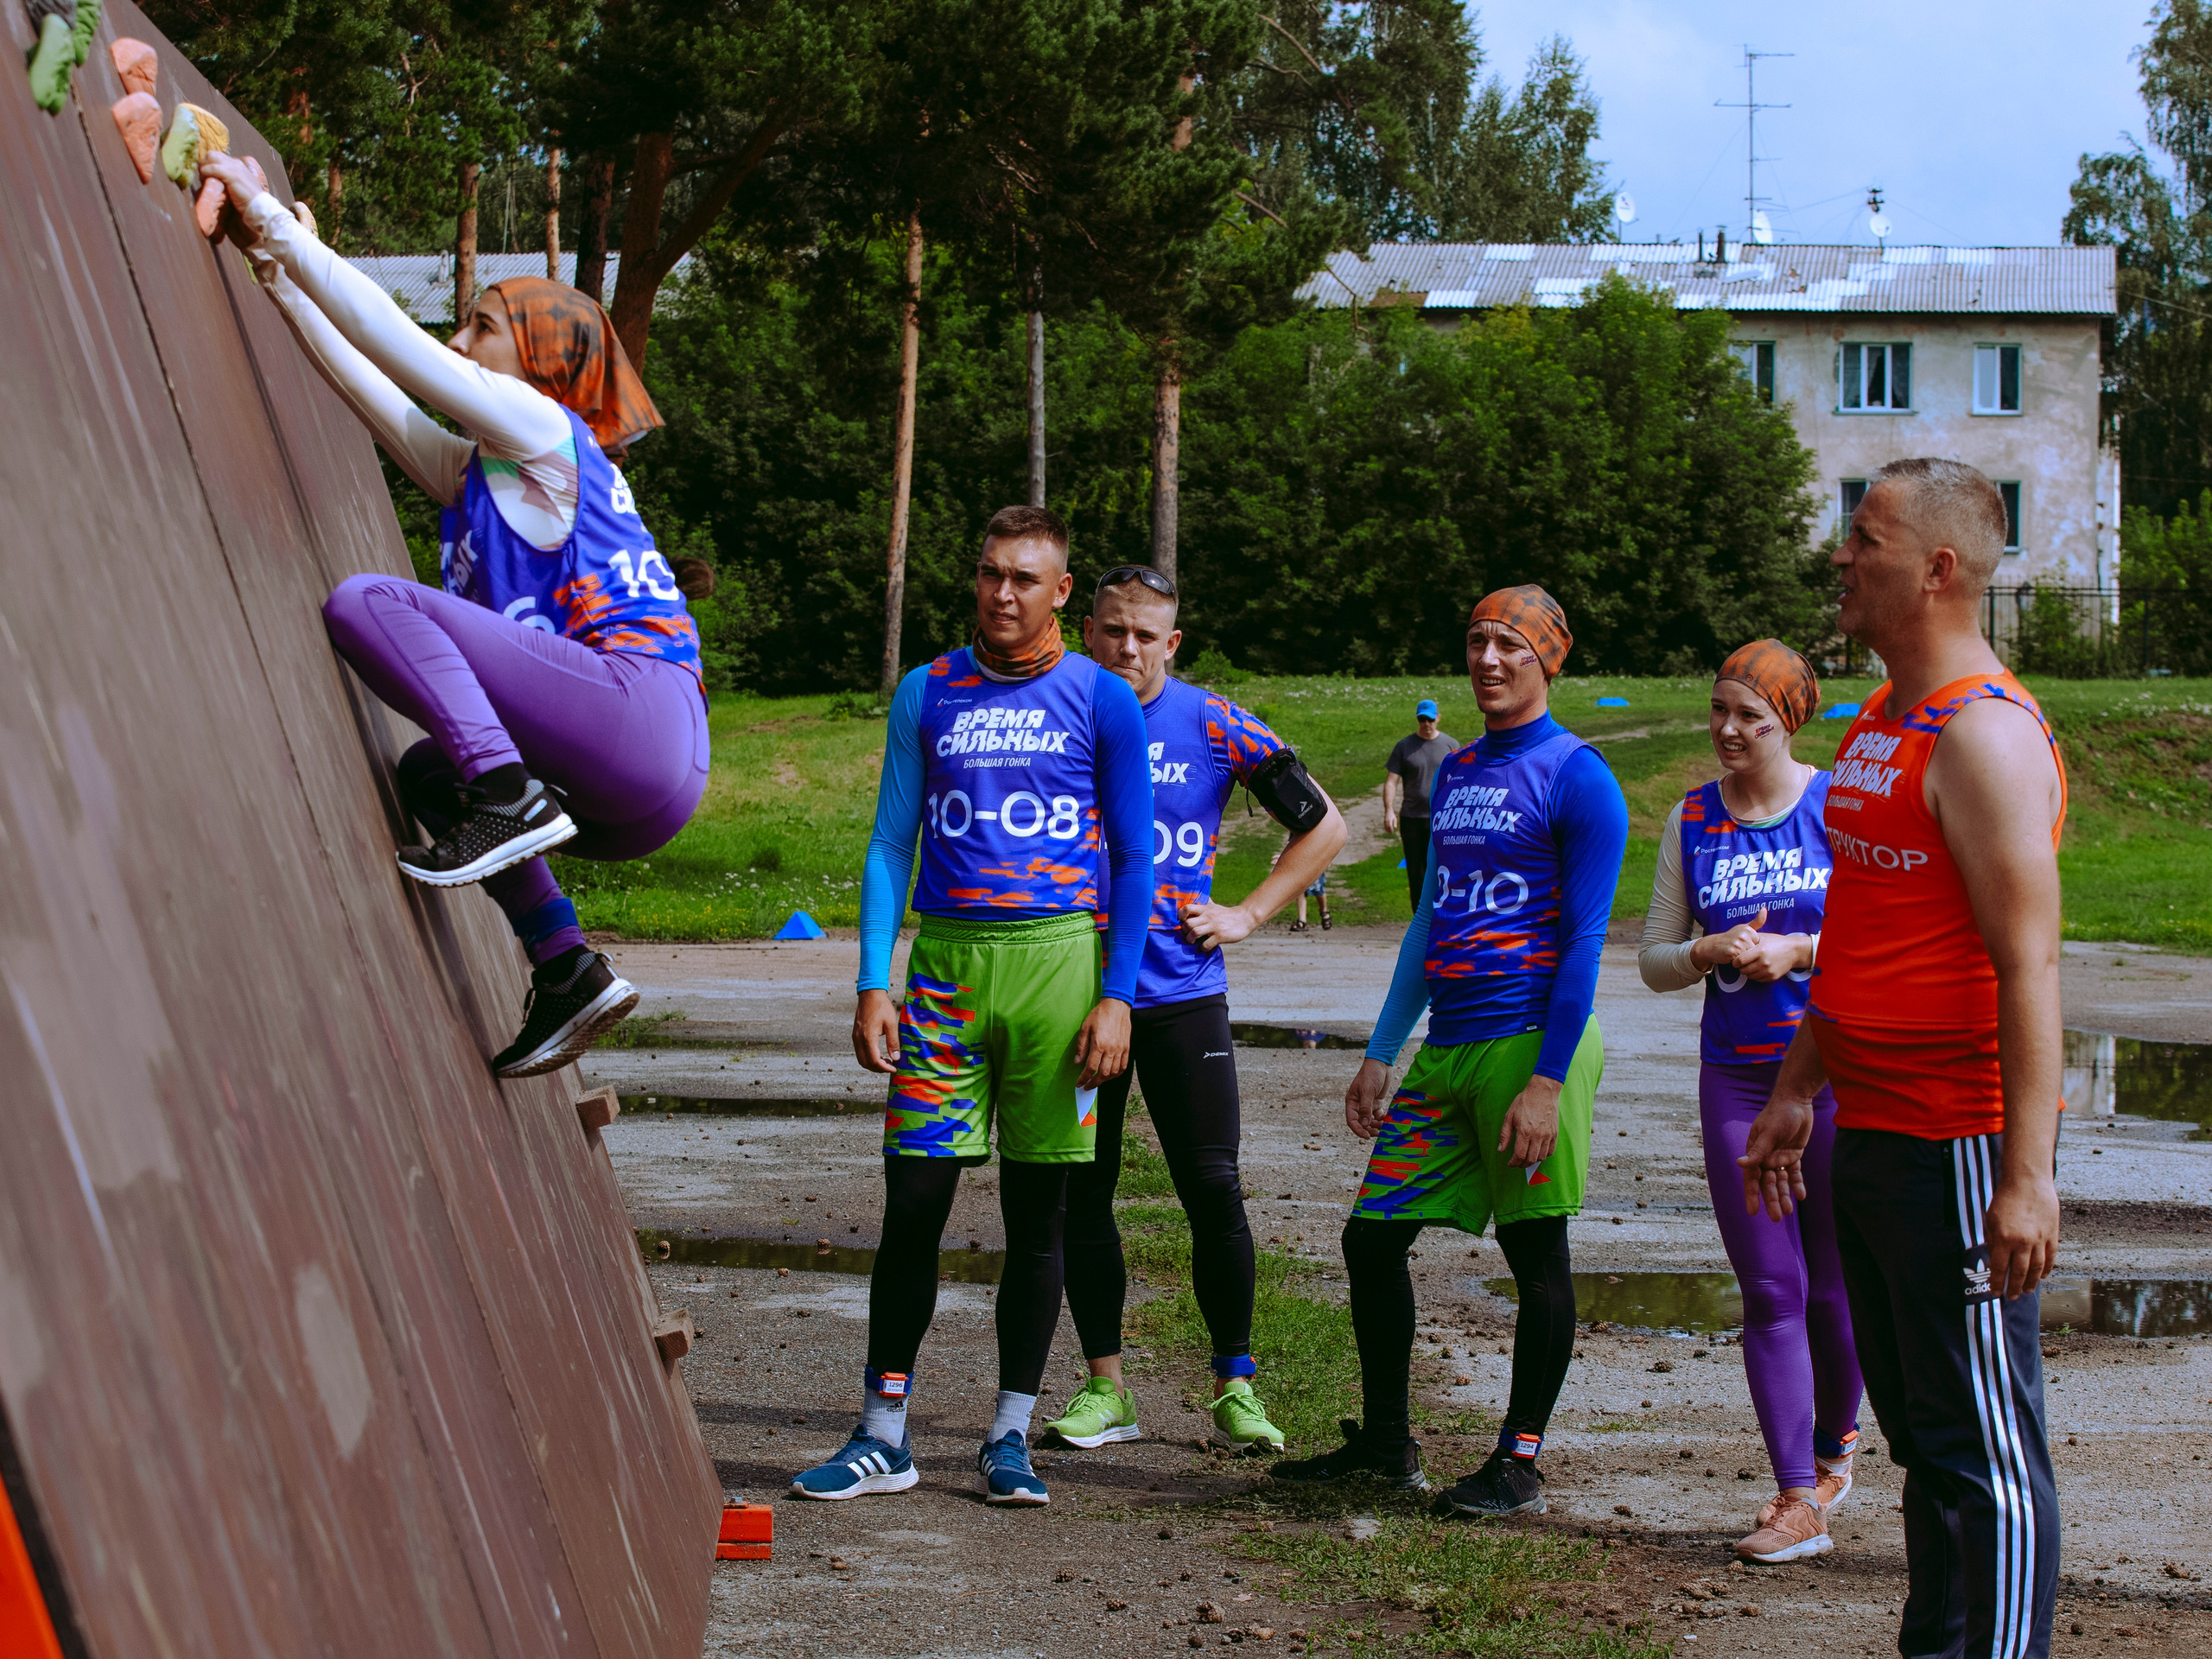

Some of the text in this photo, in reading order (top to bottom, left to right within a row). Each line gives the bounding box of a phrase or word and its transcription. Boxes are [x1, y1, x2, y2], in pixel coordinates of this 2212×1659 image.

[952, 708, 1046, 733] ВРЕМЯ
[937, 729, 1071, 757] СИЛЬНЫХ
[1844, 731, 1902, 762] ВРЕМЯ
[963, 757, 1031, 769] БОЛЬШАЯ ГОНКА
[1443, 785, 1510, 809] ВРЕМЯ
[928, 790, 1080, 840] 10-08
[1433, 807, 1522, 833] СИЛЬНЫХ
[1443, 835, 1486, 845] БОЛЬШАЯ ГОНКА
[1712, 847, 1803, 883] ВРЕМЯ
[1698, 868, 1830, 910] СИЛЬНЫХ
[1767, 897, 1795, 911] ГОНКА
